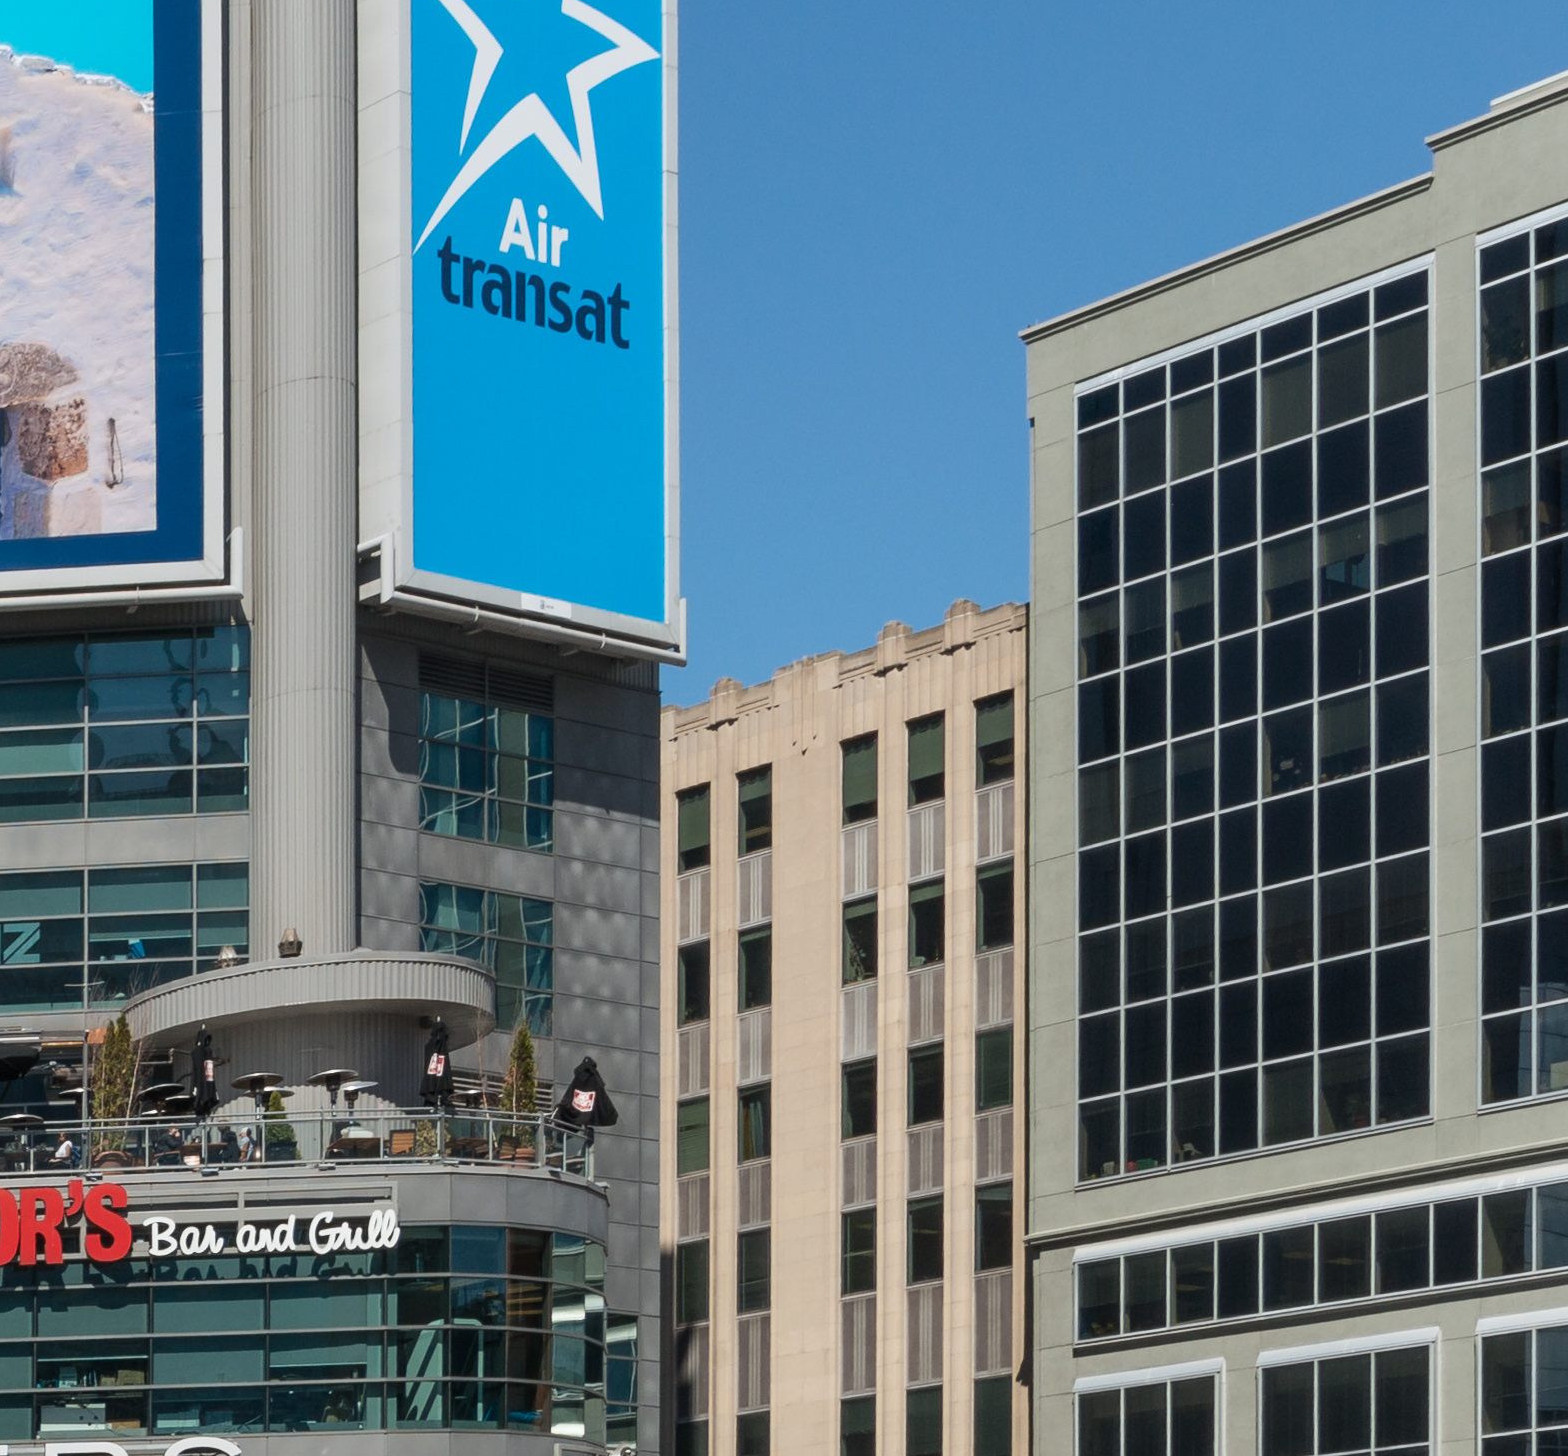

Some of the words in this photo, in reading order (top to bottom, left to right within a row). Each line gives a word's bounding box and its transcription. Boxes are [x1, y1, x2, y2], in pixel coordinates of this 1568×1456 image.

[499, 196, 570, 269] Air
[437, 233, 631, 352] transat
[144, 1215, 222, 1258] Bar
[237, 1215, 297, 1255] and
[309, 1208, 400, 1256] Grill
